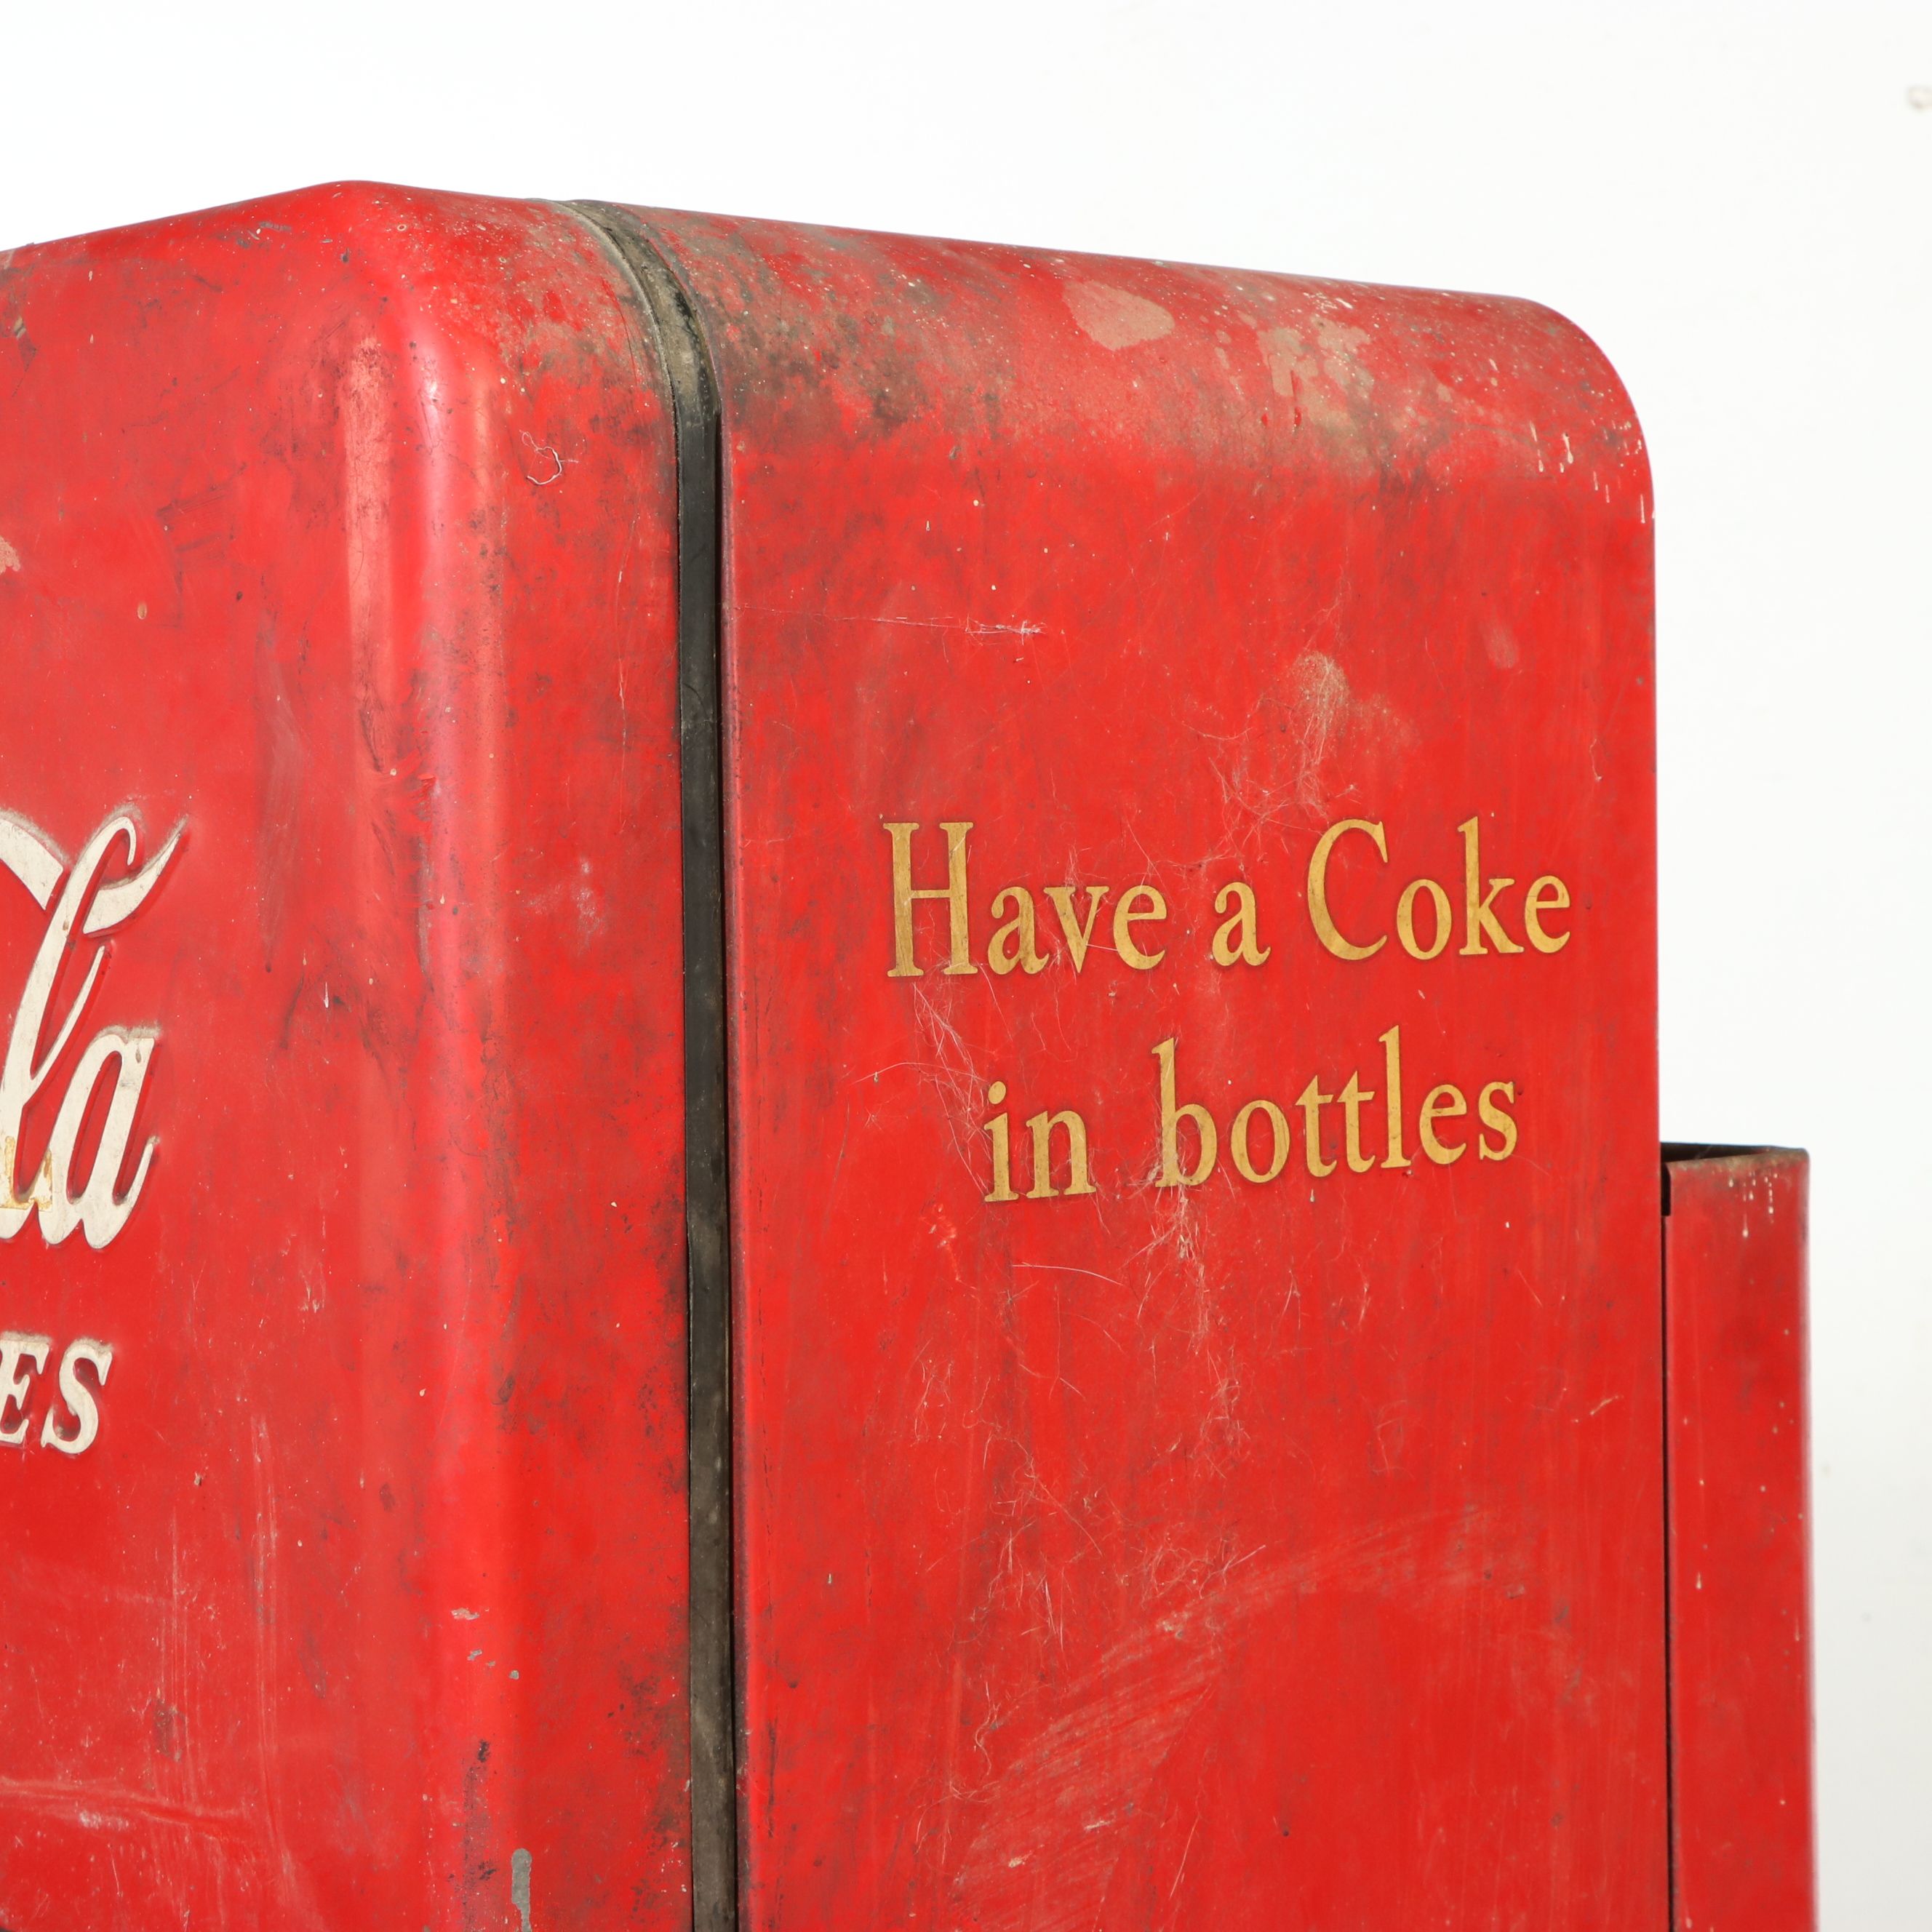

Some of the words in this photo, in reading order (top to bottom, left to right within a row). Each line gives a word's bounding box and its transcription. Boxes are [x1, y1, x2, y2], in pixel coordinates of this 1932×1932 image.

[882, 821, 1168, 978] Have
[1211, 882, 1271, 967] a
[1309, 815, 1571, 961] Coke
[983, 1080, 1096, 1203] in
[1151, 1025, 1518, 1189] bottles
